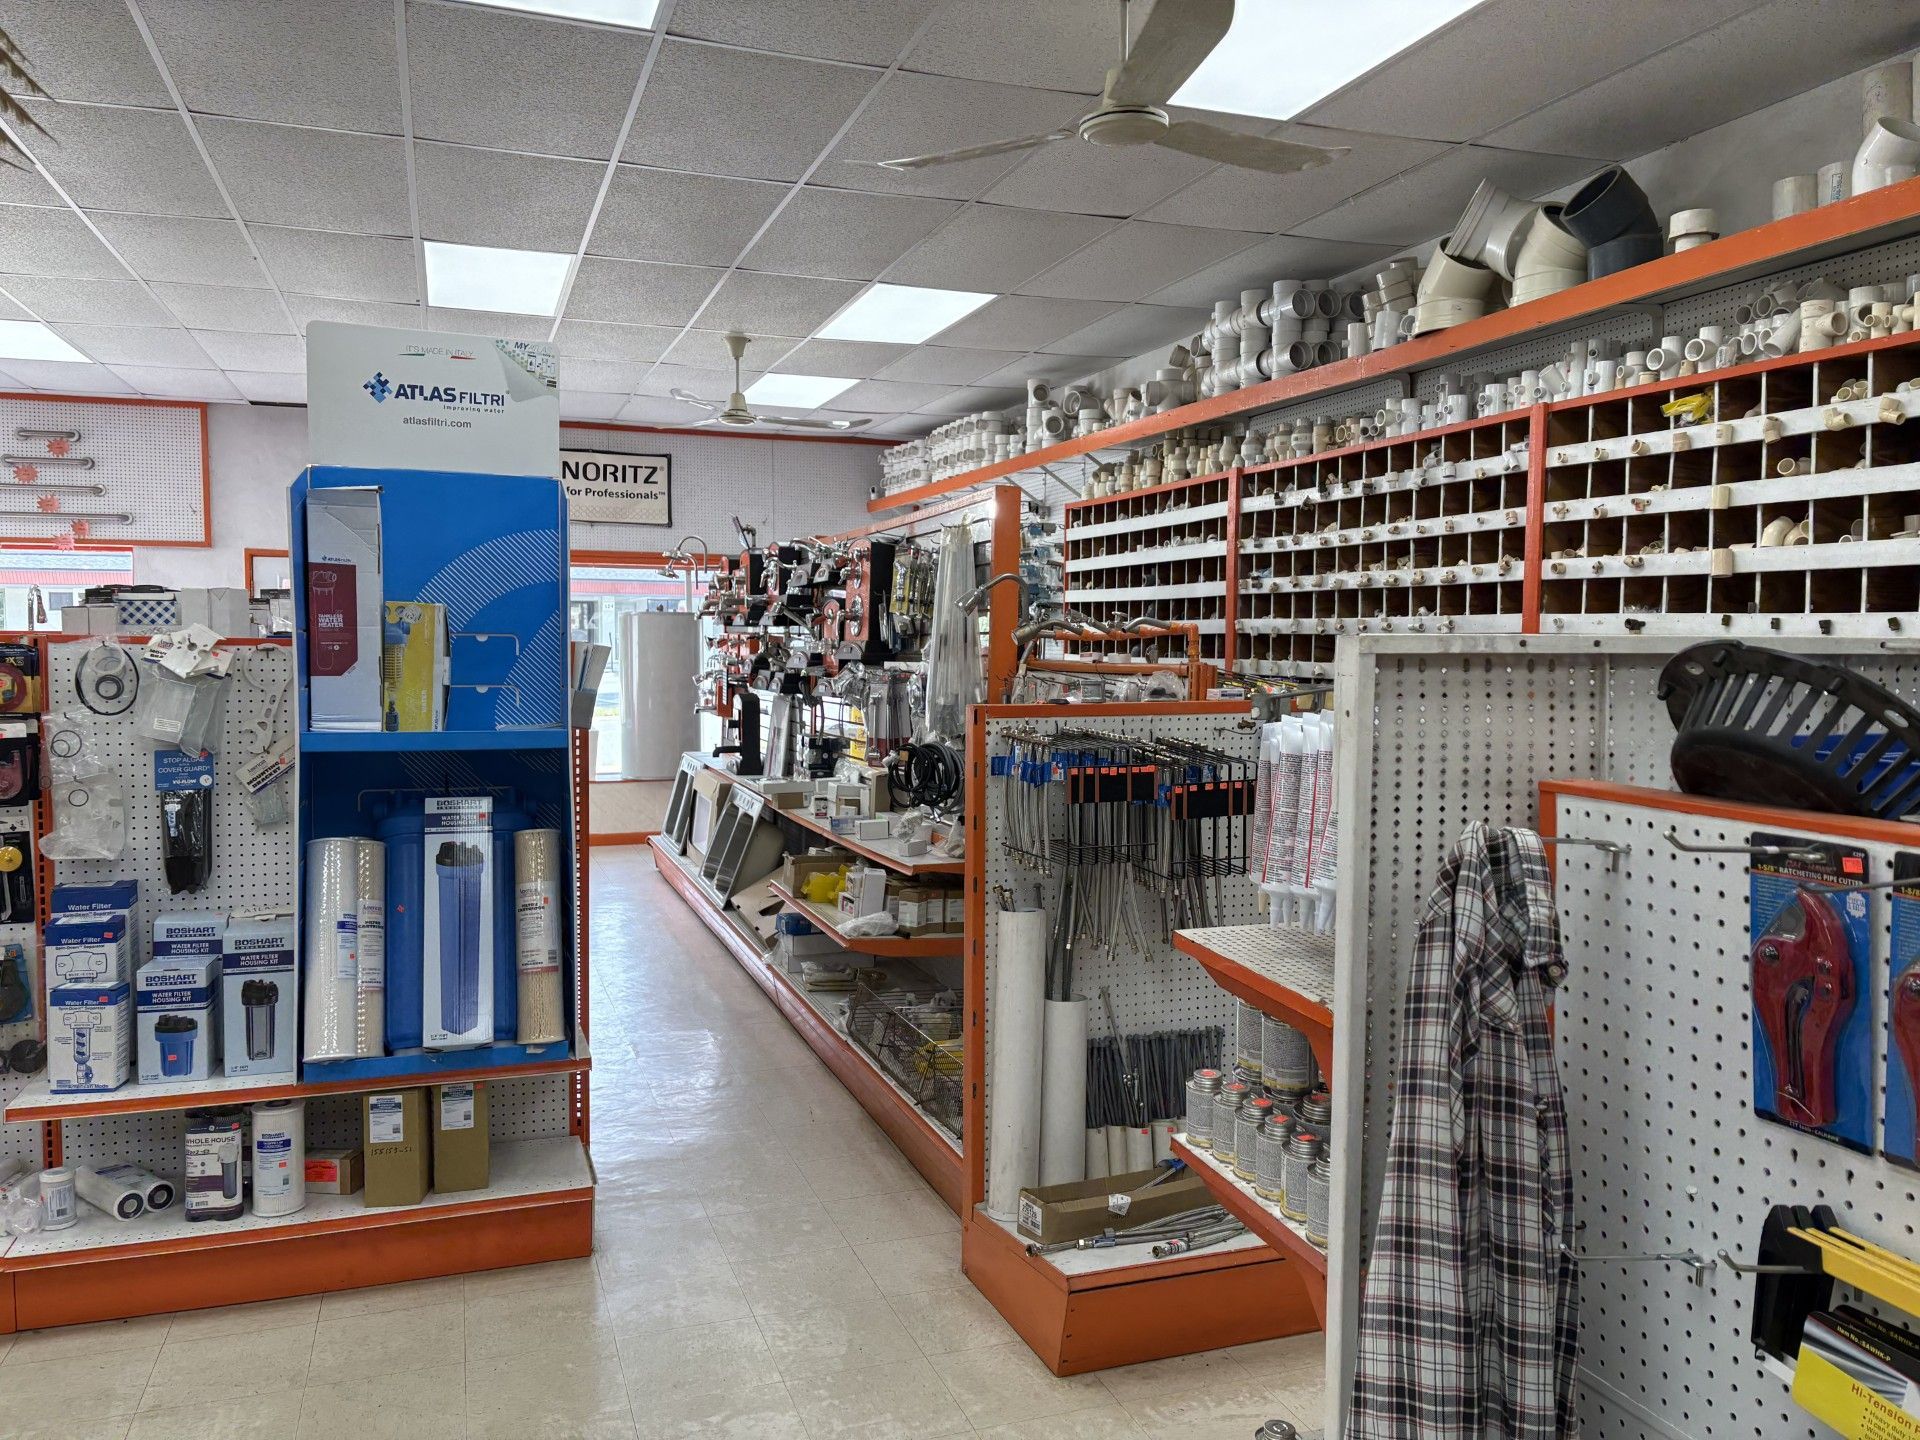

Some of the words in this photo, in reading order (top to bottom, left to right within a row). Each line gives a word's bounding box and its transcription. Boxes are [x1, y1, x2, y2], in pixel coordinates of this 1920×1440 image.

[421, 346, 443, 355] MADE
[454, 349, 474, 357] ITALY
[394, 383, 457, 403] ATLAS
[459, 391, 505, 407] FILTRI
[402, 416, 472, 429] atlasfiltri.com
[566, 486, 582, 496] for
[246, 760, 280, 786] MOUNTING
[251, 766, 282, 789] BRACKET
[1779, 866, 1822, 880] RATCHETING
[1823, 873, 1838, 883] PIPE
[166, 926, 216, 934] BOSHART
[235, 937, 284, 946] BOSHART
[145, 974, 196, 982] BOSHART
[211, 1135, 236, 1143] HOUSE
[1837, 1324, 1850, 1338] Item
[1851, 1383, 1912, 1430] Hi-Tension
[1869, 1409, 1891, 1428] Heavy
[1891, 1425, 1906, 1439] duty
[1873, 1422, 1886, 1433] can
